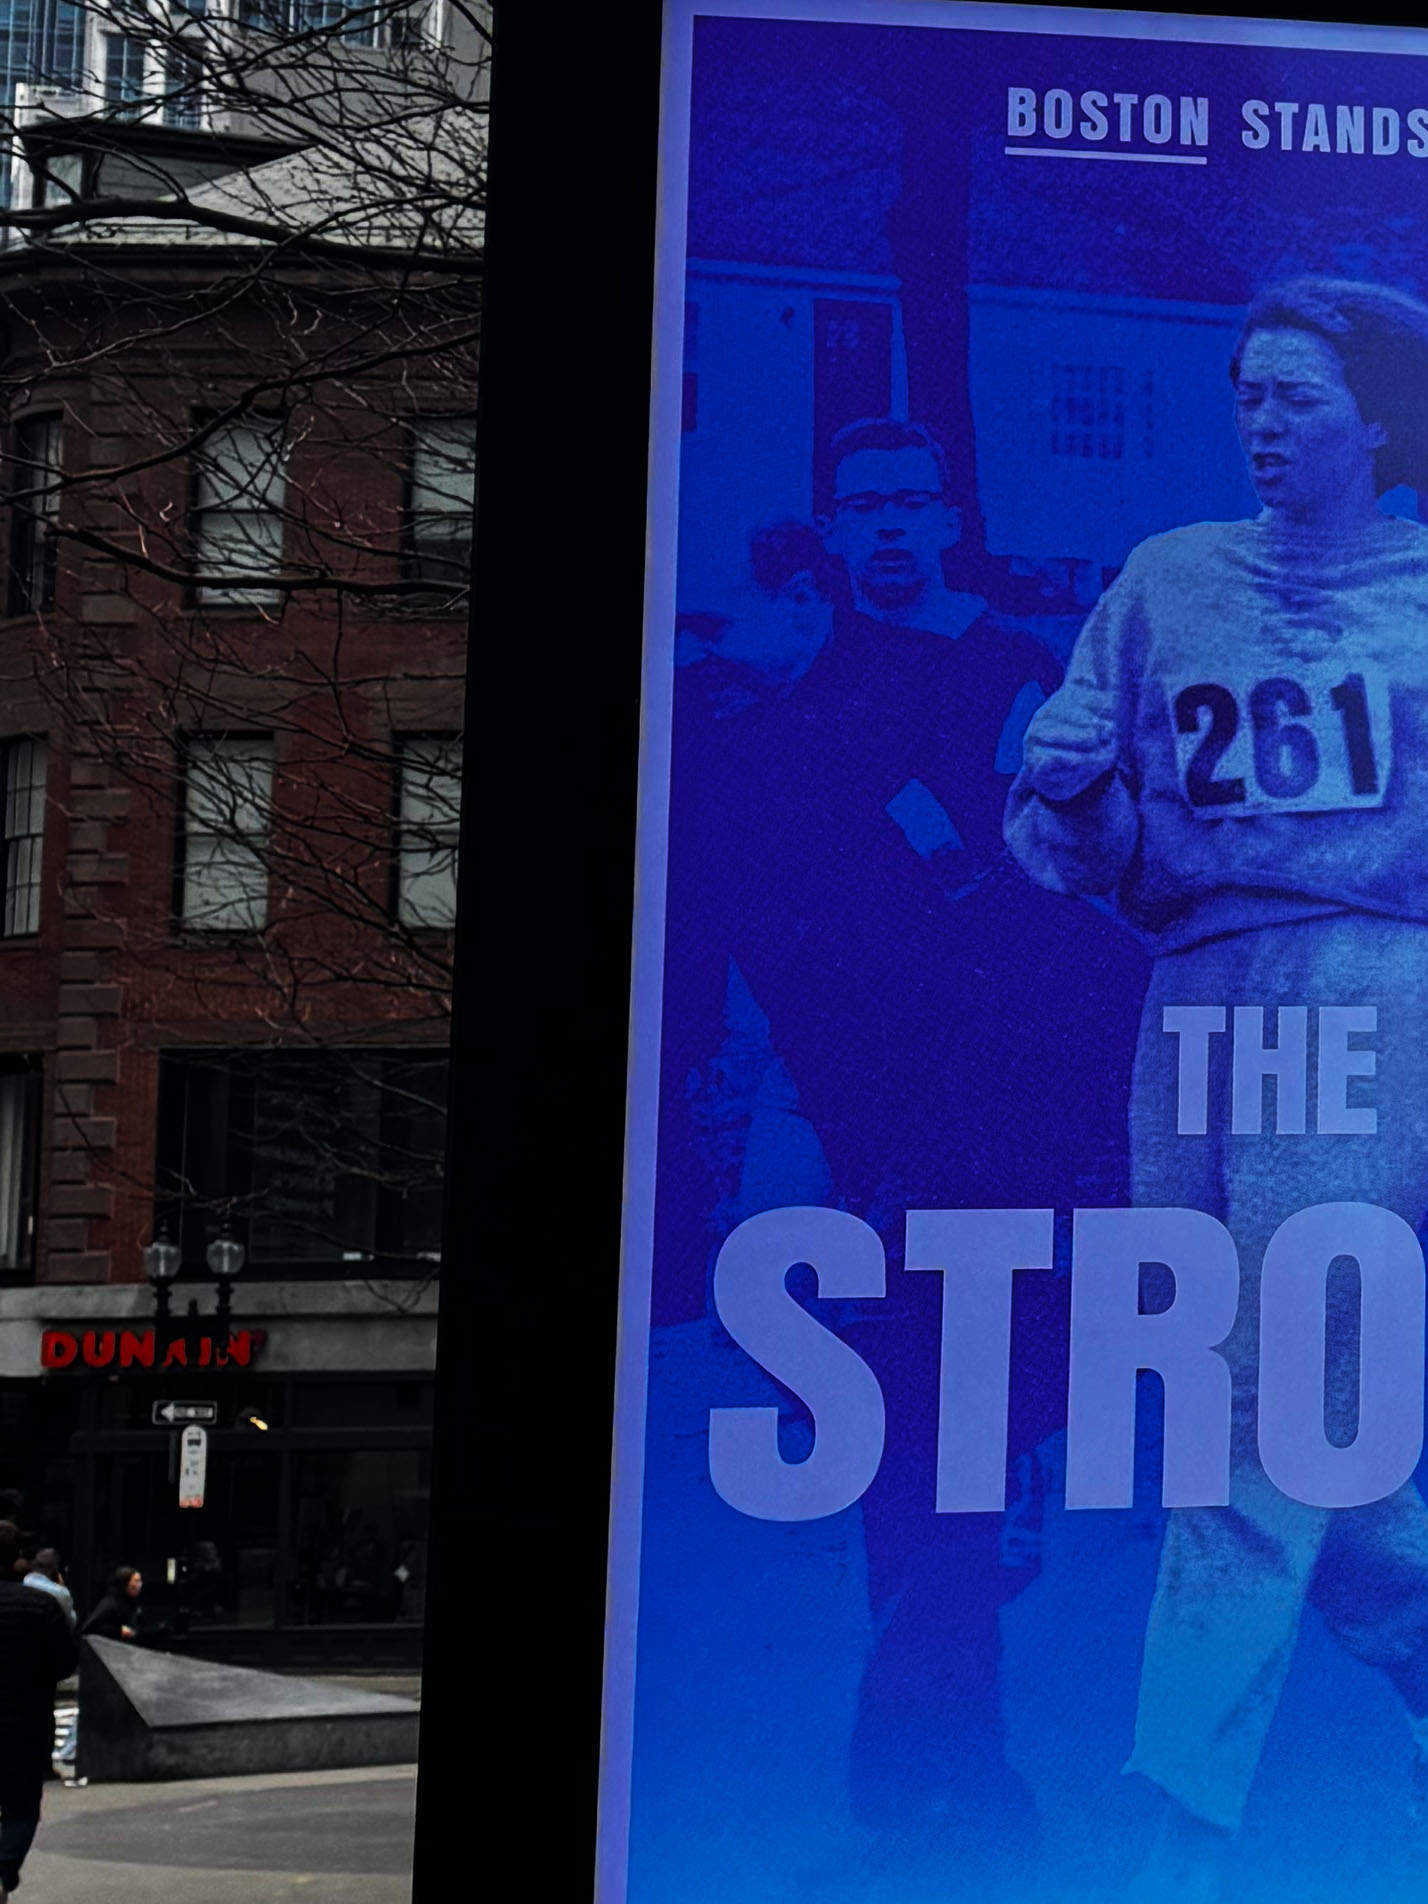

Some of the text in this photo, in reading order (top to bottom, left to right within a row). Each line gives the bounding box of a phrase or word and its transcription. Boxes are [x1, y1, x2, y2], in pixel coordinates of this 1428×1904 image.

[1005, 86, 1209, 146] BOSTON
[1174, 672, 1381, 807] 261
[1162, 1006, 1379, 1136] THE
